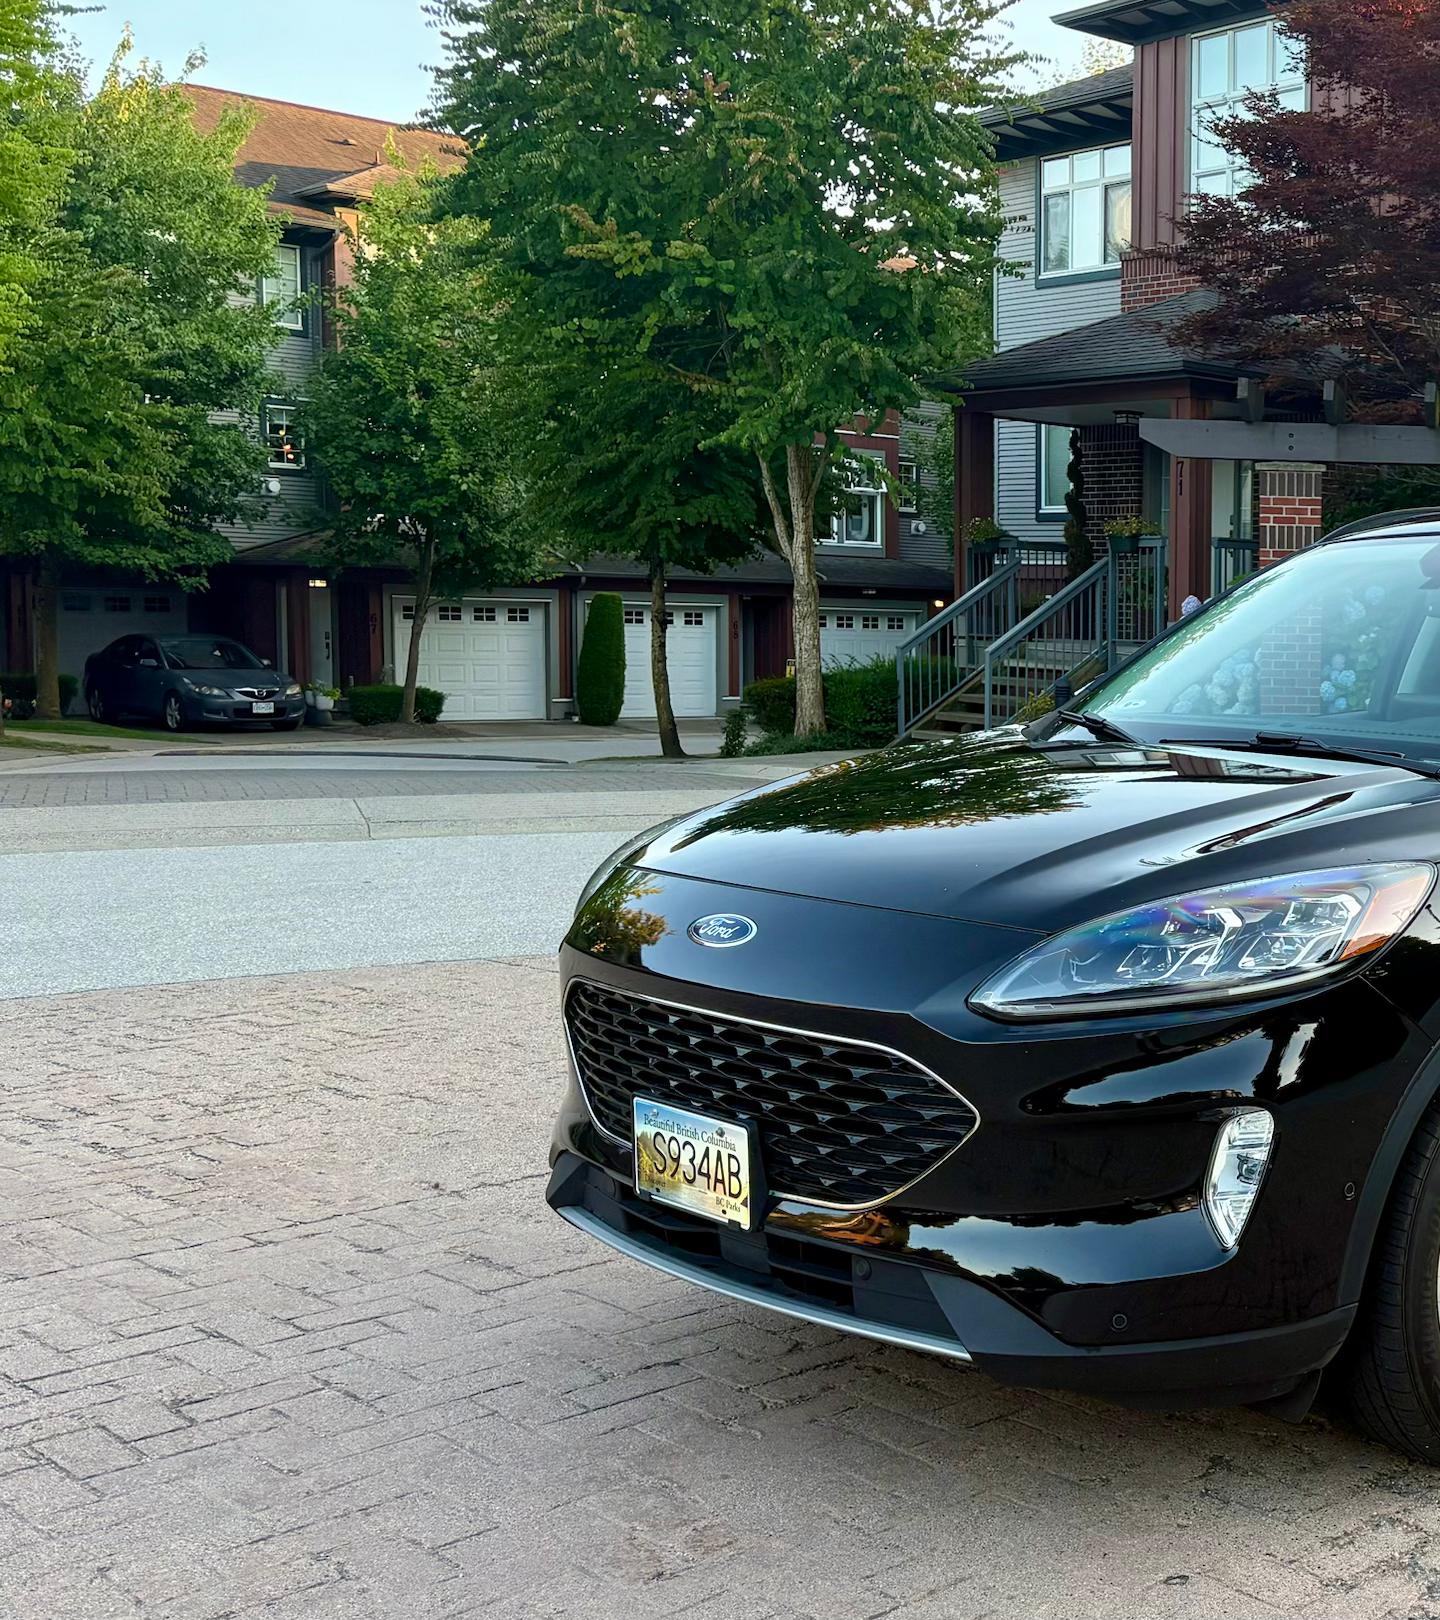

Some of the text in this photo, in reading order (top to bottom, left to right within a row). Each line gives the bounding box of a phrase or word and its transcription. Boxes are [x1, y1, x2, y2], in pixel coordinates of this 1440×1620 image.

[1176, 461, 1184, 496] 71
[699, 917, 740, 939] Ford
[644, 1114, 736, 1152] Beautiful British Columbia
[653, 1131, 742, 1199] S934AB
[715, 1196, 741, 1213] BC Parks
